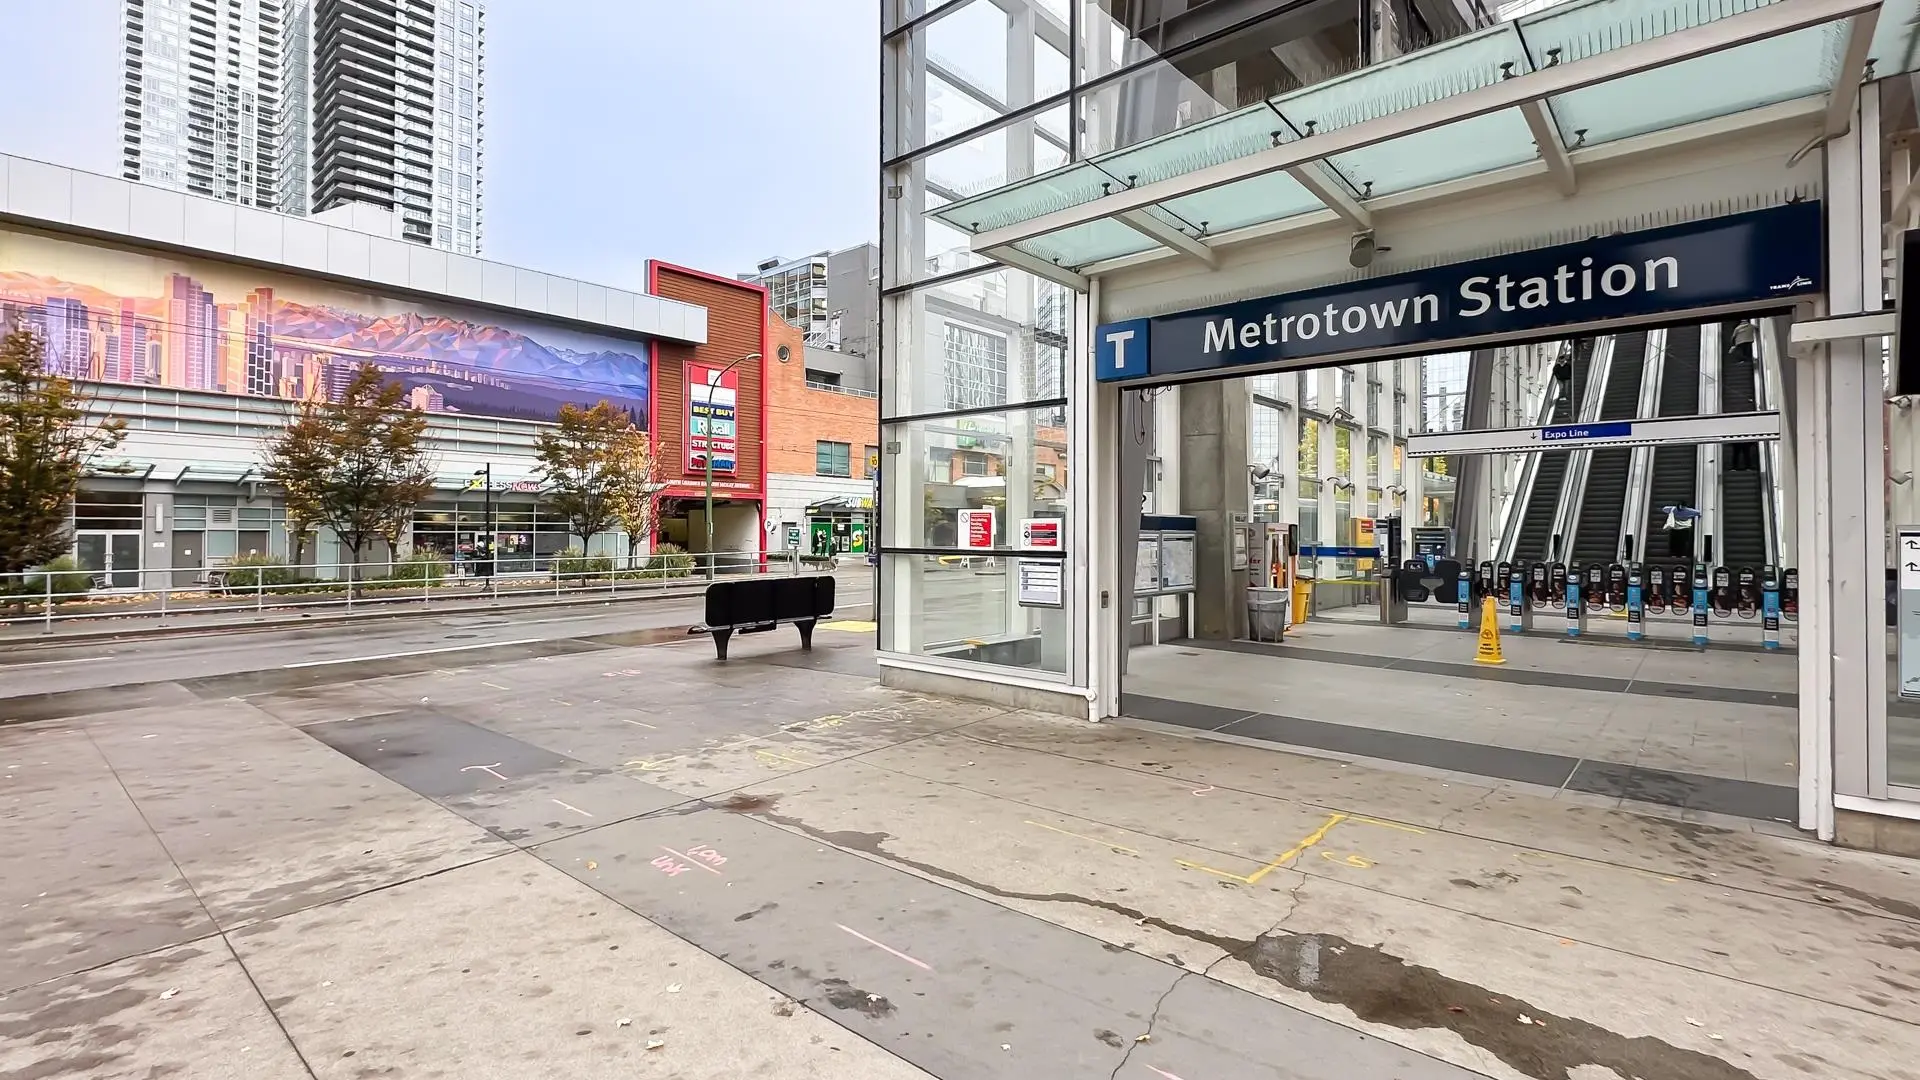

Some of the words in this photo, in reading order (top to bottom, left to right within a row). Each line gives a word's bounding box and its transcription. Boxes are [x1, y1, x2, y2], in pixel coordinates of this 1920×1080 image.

[1106, 330, 1135, 369] T
[1203, 292, 1438, 353] Metrotown
[1459, 255, 1679, 318] Station
[715, 408, 735, 417] BUY
[697, 419, 730, 436] Rxall
[1544, 430, 1567, 440] Expo
[1569, 428, 1590, 438] Line
[692, 440, 735, 450] STRCTUBE
[845, 497, 875, 509] SUBWA
